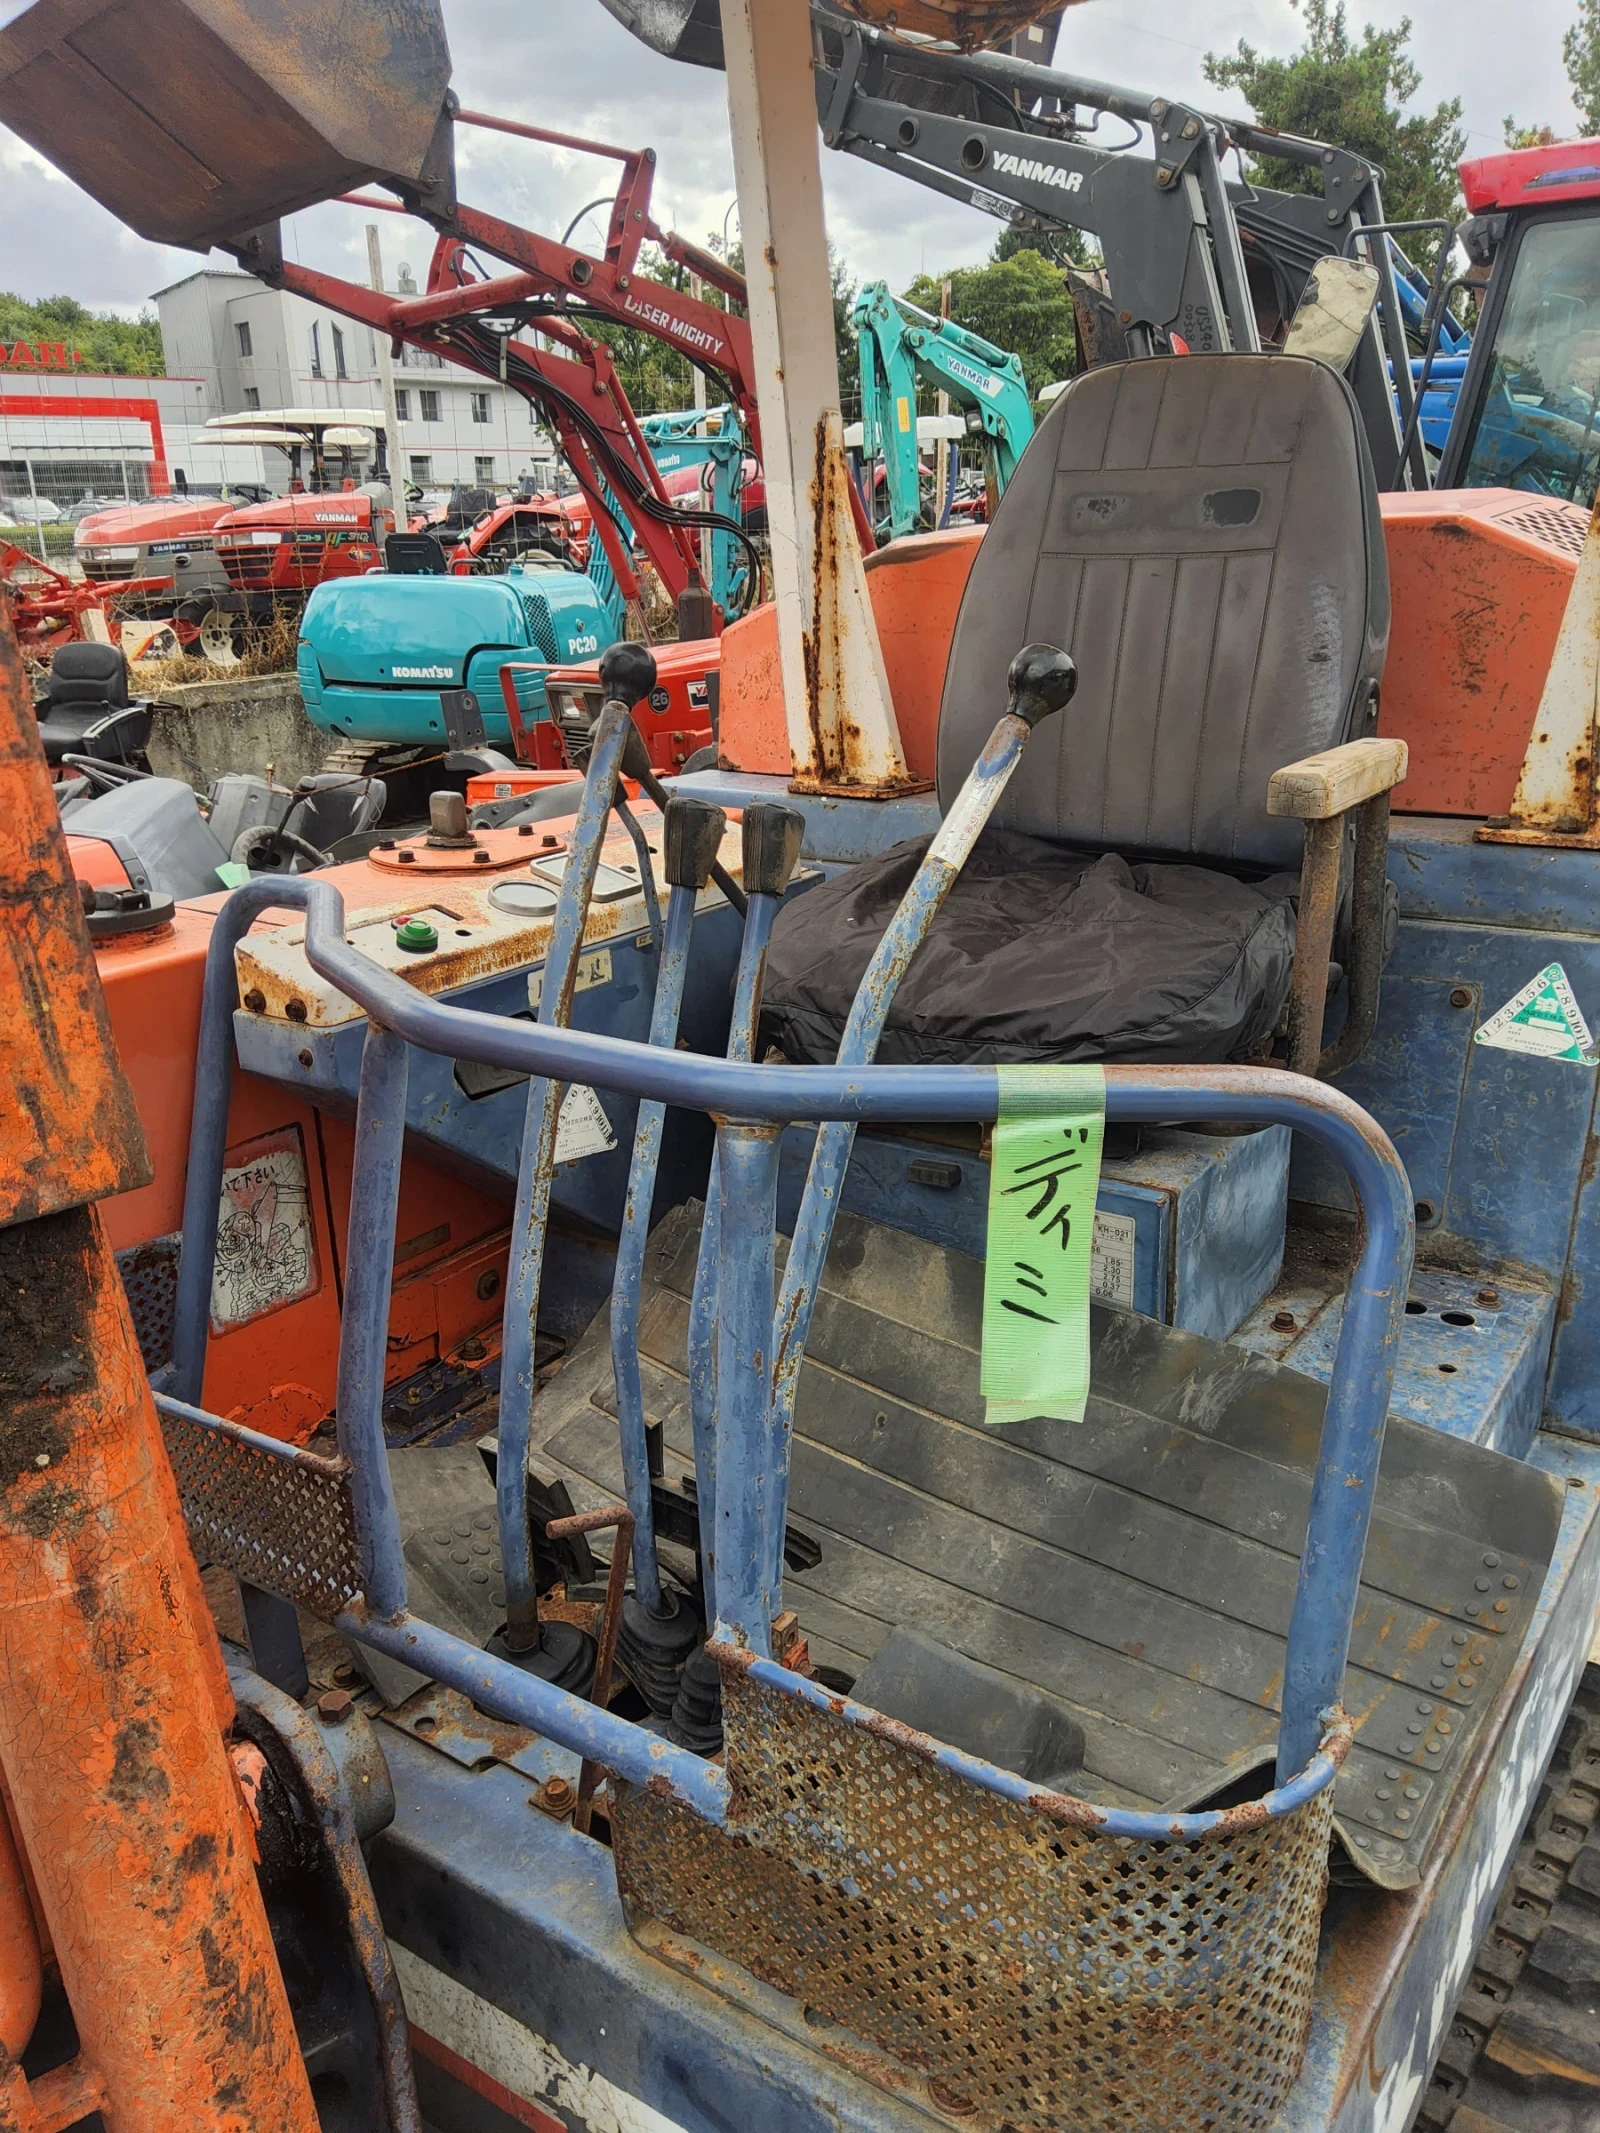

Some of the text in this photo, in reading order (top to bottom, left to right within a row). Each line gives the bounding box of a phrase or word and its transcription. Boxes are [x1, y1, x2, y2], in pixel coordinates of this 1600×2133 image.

[993, 150, 1084, 193] YANMAR
[669, 317, 724, 355] MIGHTY
[946, 355, 990, 391] YANMAR
[153, 543, 187, 552] YANMAR
[569, 635, 598, 655] PC20
[391, 665, 454, 679] KOMATSU
[652, 692, 669, 707] 26
[1556, 983, 1567, 992] 7
[1561, 996, 1572, 1005] 8
[1483, 980, 1547, 1038] 1 2 3 4 5 6
[1566, 1009, 1577, 1018] 9
[571, 1089, 578, 1097] 6
[588, 1097, 595, 1105] 8
[593, 1106, 599, 1114] 9
[1097, 1225, 1129, 1239] KH-021
[1103, 1264, 1121, 1275] 2.30
[1103, 1273, 1121, 1283] 2.75
[1102, 1281, 1120, 1291] 0.37
[1095, 1287, 1114, 1298] 0.06
